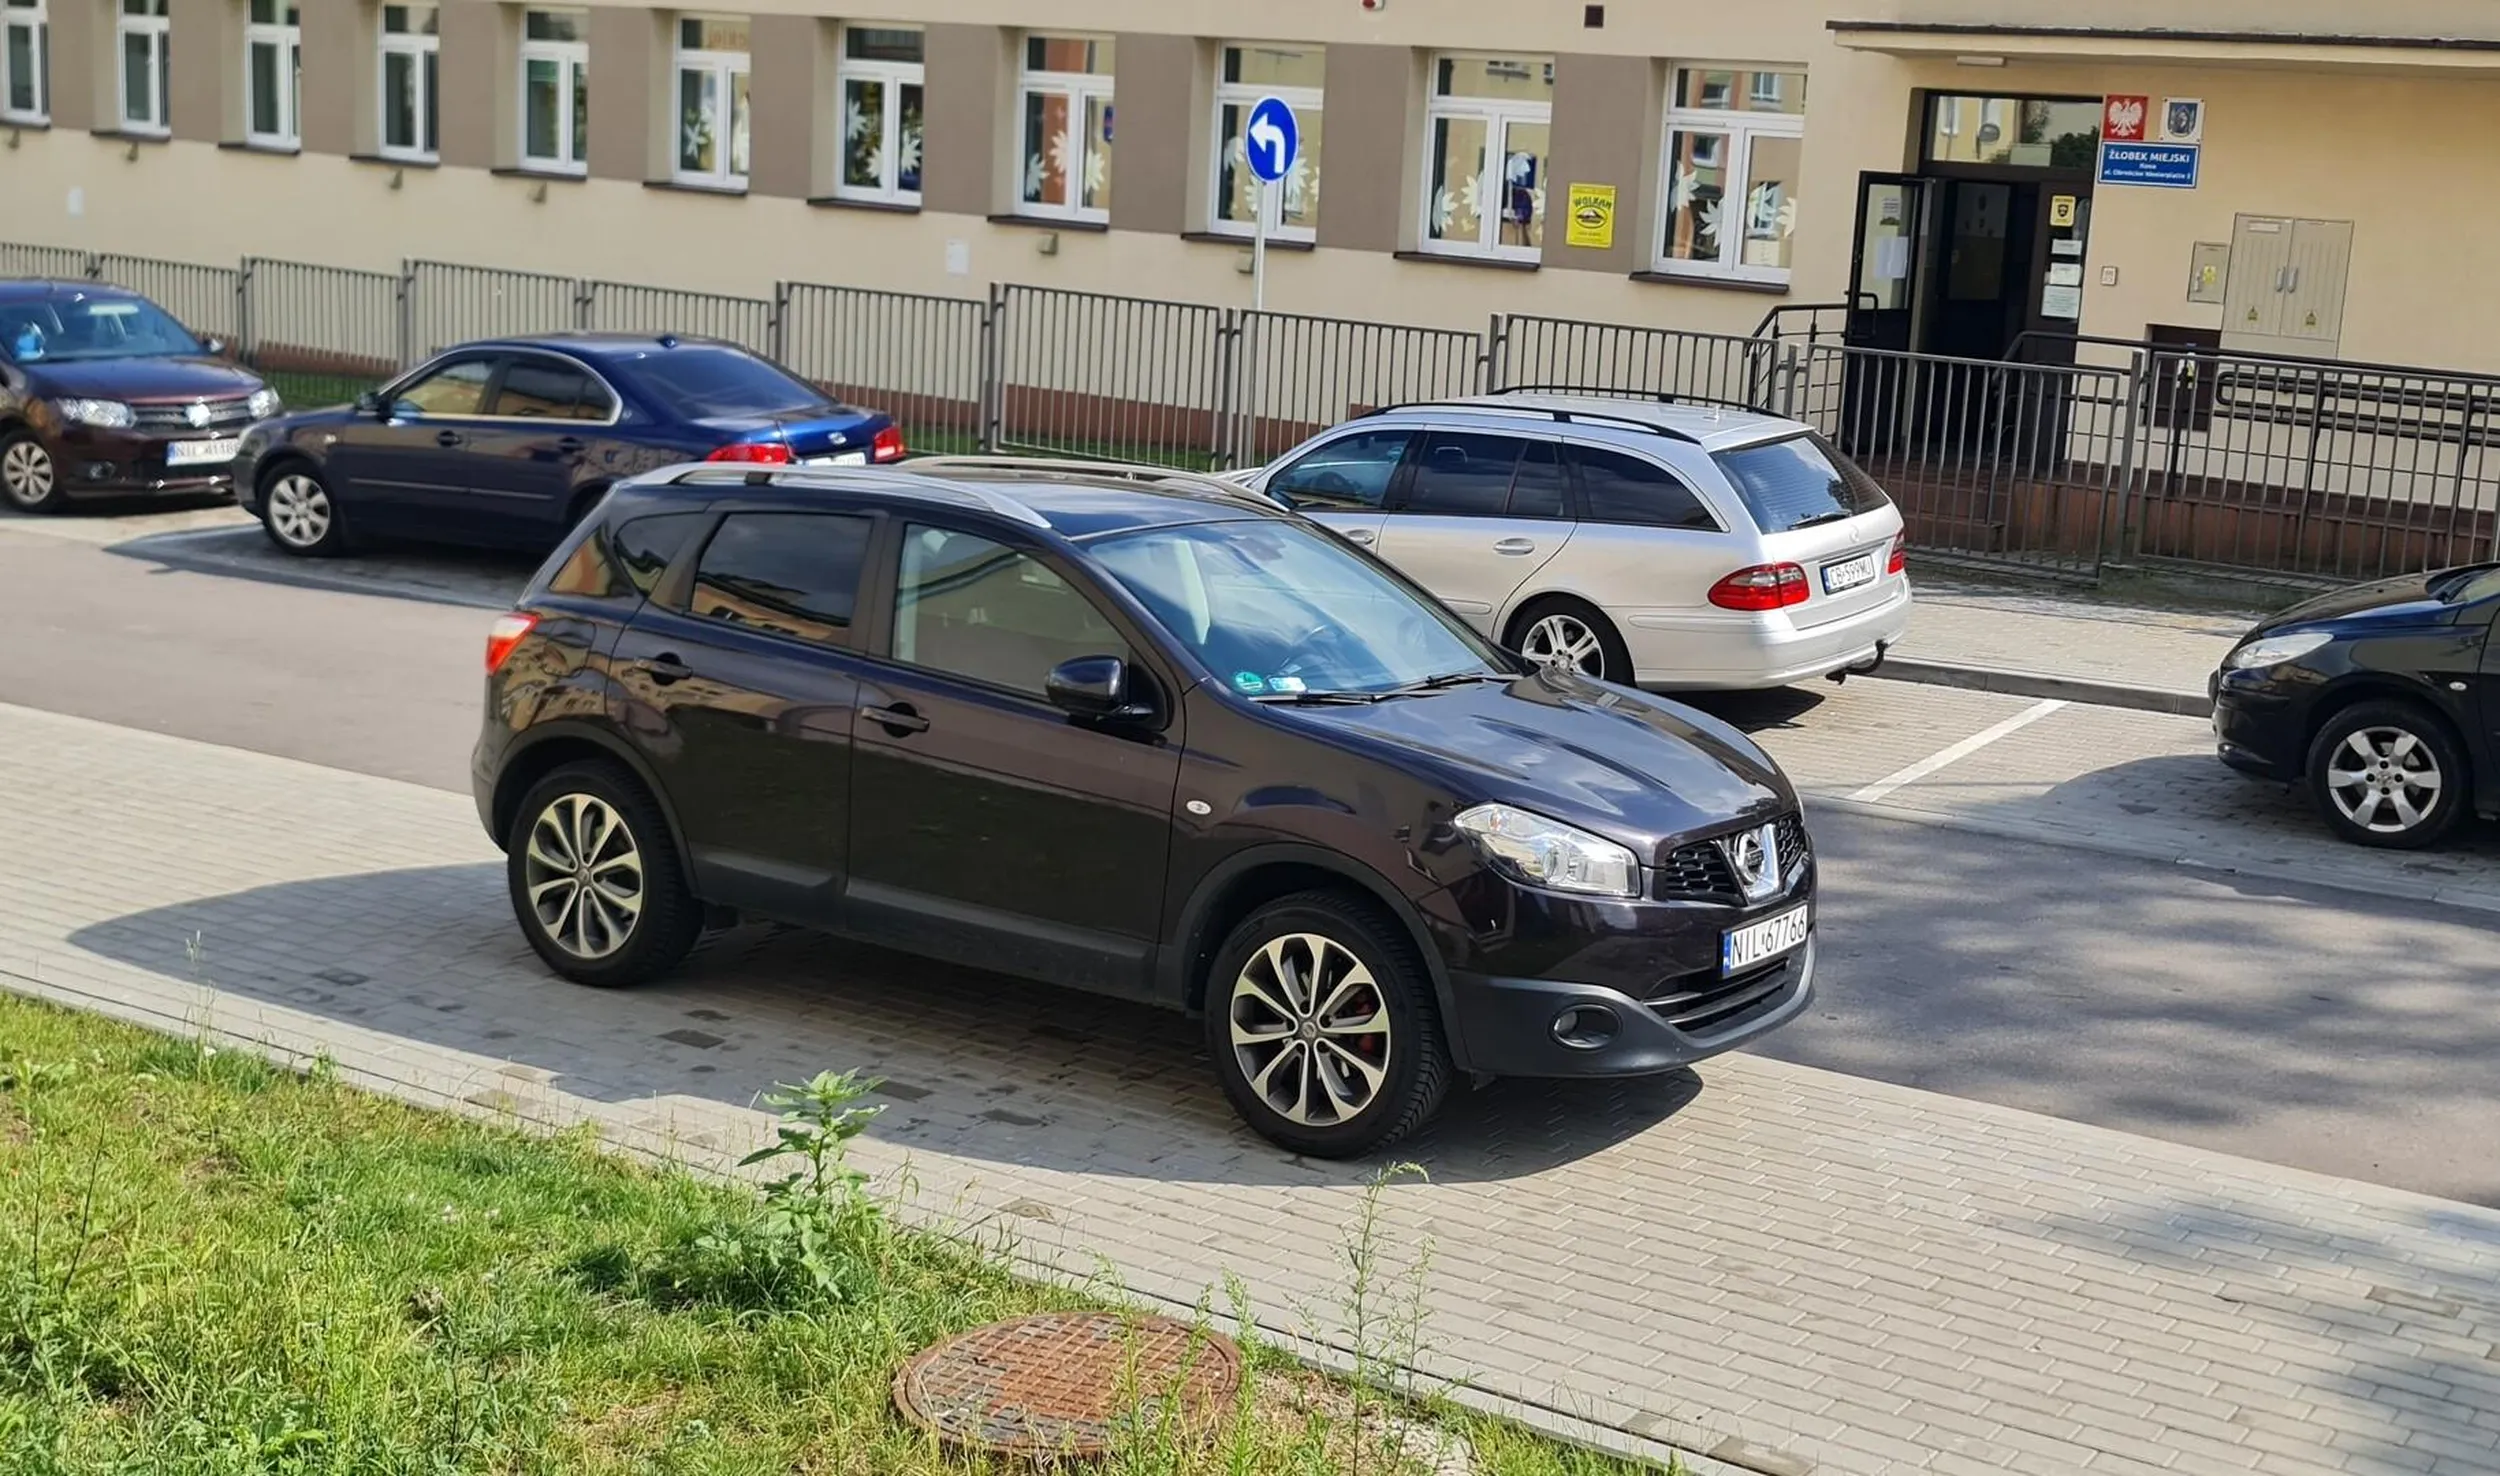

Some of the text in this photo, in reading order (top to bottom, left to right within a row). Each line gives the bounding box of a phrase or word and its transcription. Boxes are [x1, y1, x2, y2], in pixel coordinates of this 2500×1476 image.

[2108, 149, 2190, 163] ŻŁOBEK MIEJSKI
[1732, 907, 1805, 967] NIL 67766
